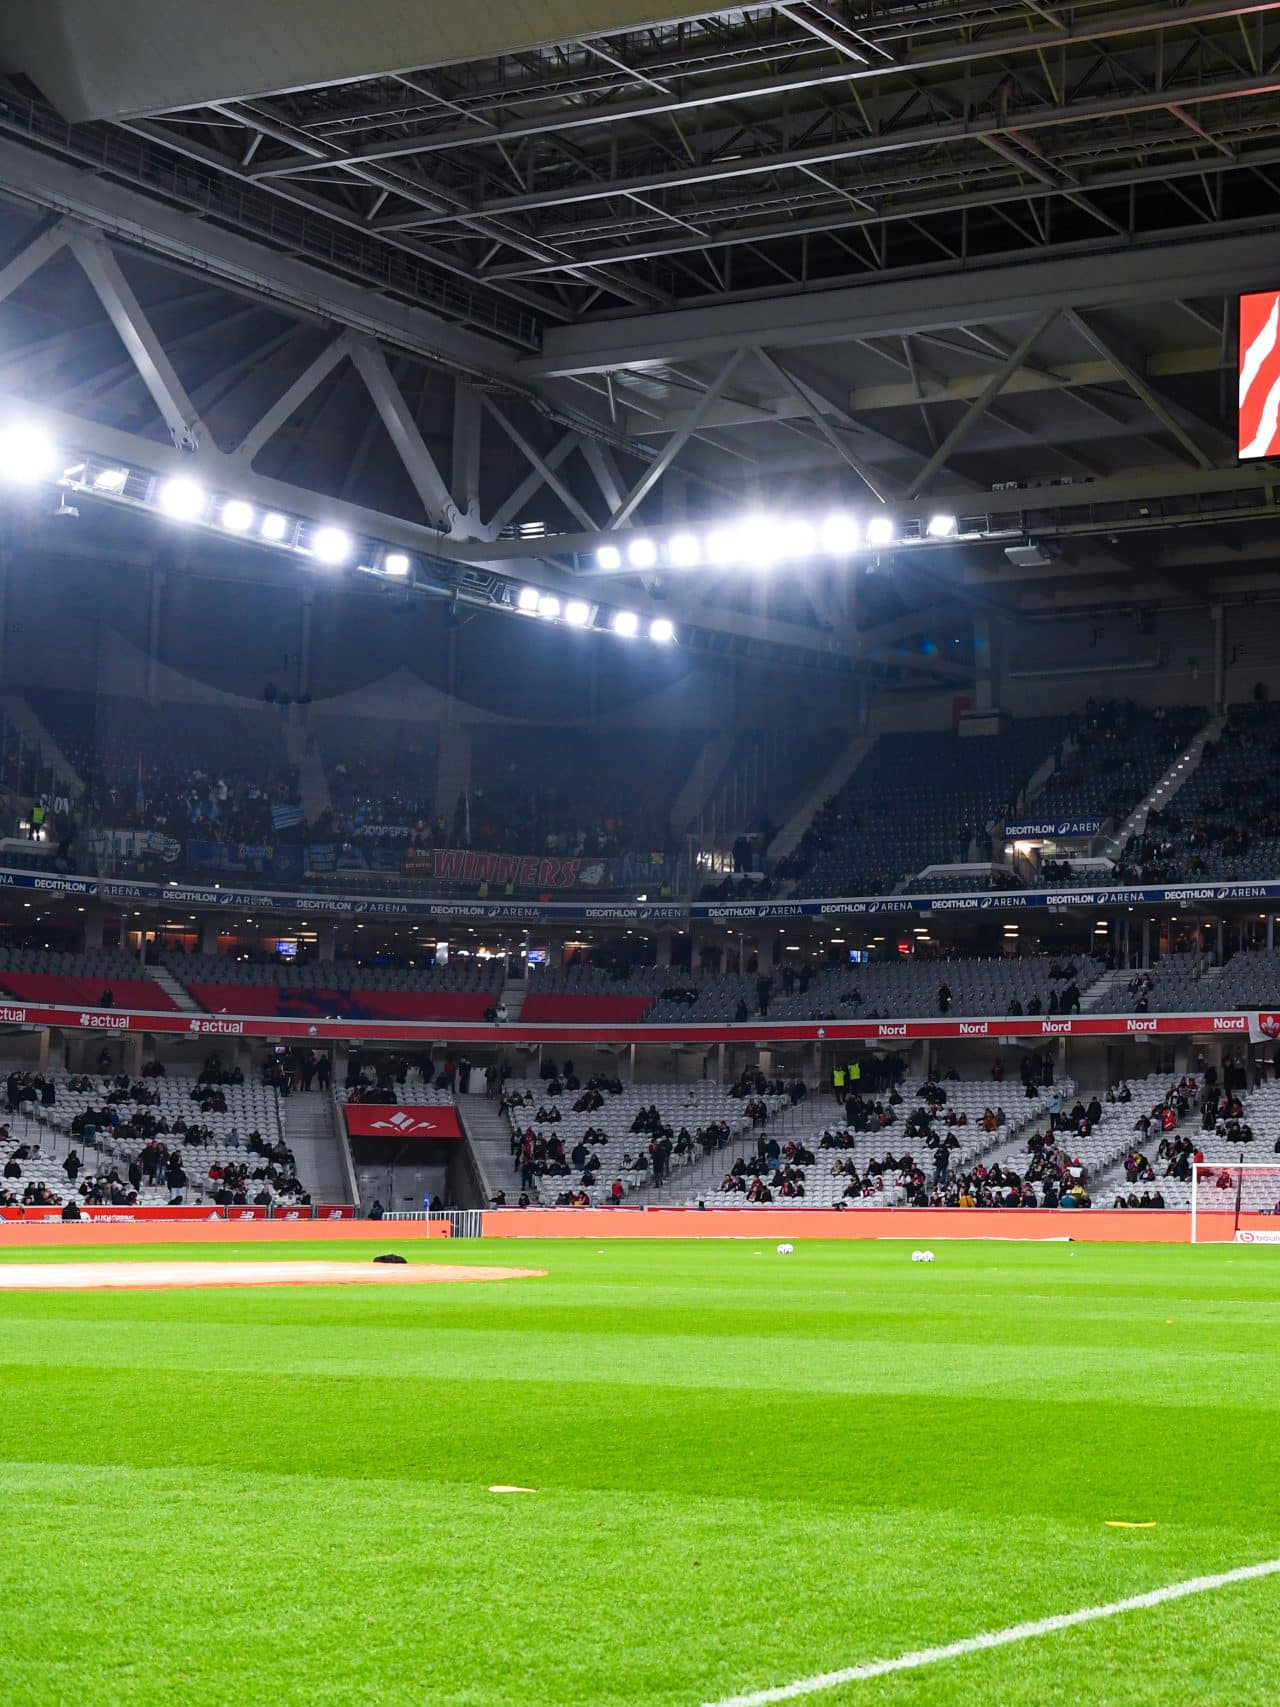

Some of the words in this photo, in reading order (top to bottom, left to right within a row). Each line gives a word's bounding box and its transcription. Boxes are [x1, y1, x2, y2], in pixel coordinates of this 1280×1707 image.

[1005, 825, 1055, 836] DECATHLON
[1072, 822, 1100, 832] AREN
[434, 852, 580, 888] WINNERS
[35, 879, 86, 892] DECATHLON
[104, 885, 140, 897] ARENA
[1165, 889, 1214, 900] DECATHLON
[1231, 887, 1266, 897] ARENA
[163, 890, 217, 902] DECATHLON
[1047, 895, 1094, 905] DECATHLON
[1110, 892, 1144, 902] ARENA
[297, 899, 351, 911] DECATHLON
[370, 904, 407, 913] ARENA
[821, 904, 866, 913] DECATHLON
[880, 902, 913, 911] ARENA
[932, 899, 977, 909] DECATHLON
[994, 897, 1026, 906] ARENA
[430, 906, 484, 916] DECATHLON
[503, 908, 539, 917] ARENA
[586, 909, 637, 918] DECATHLON
[654, 909, 688, 918] ARENA
[708, 907, 756, 917] DECATHLON
[771, 906, 803, 915] ARENA
[90, 1014, 129, 1028] actual
[201, 1020, 243, 1033] actual
[1042, 1021, 1072, 1032] Nord
[1127, 1019, 1157, 1030] Nord
[1213, 1018, 1244, 1029] Nord
[879, 1024, 907, 1035] Nord
[959, 1023, 988, 1033] Nord
